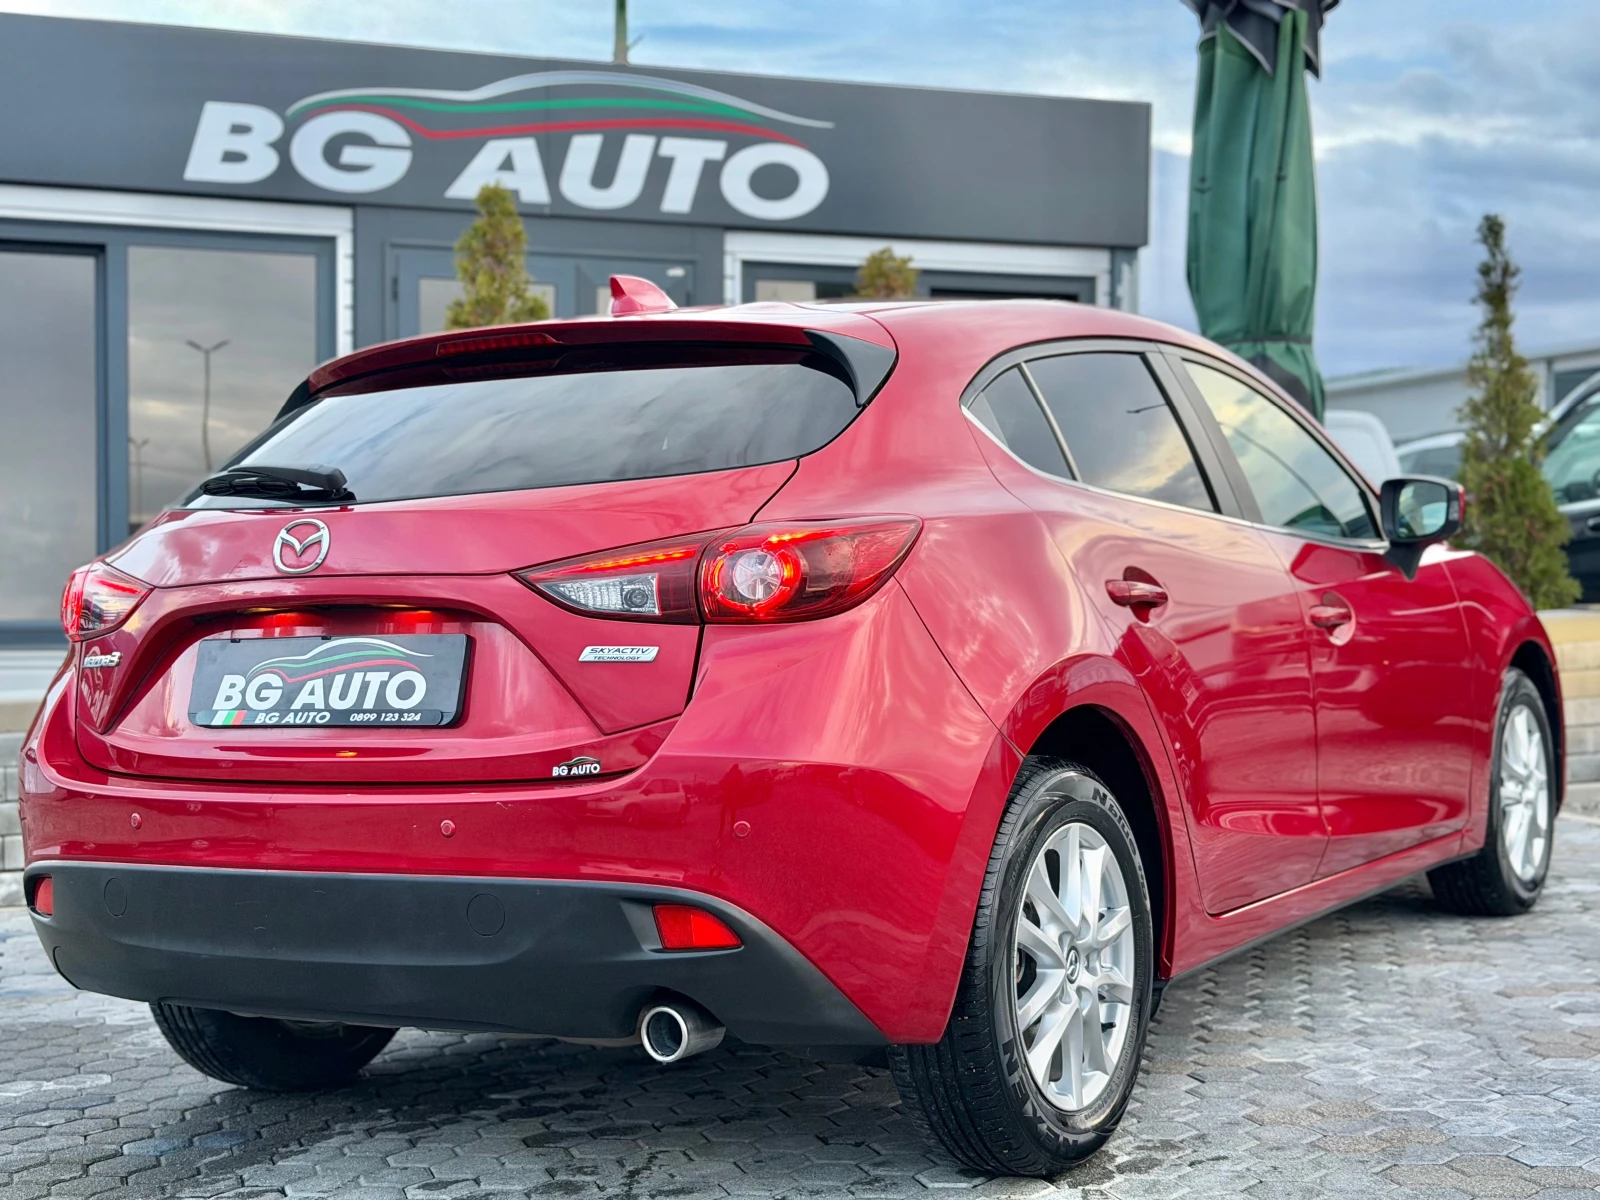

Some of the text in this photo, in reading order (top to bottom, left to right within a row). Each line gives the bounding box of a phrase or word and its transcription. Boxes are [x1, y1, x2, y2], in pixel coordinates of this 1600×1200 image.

[183, 100, 831, 221] BG AUTO
[212, 670, 427, 710] BG AUTO
[254, 711, 331, 724] BG AUTO
[349, 712, 422, 722] 0899 123 324
[552, 763, 600, 776] BG AUTO
